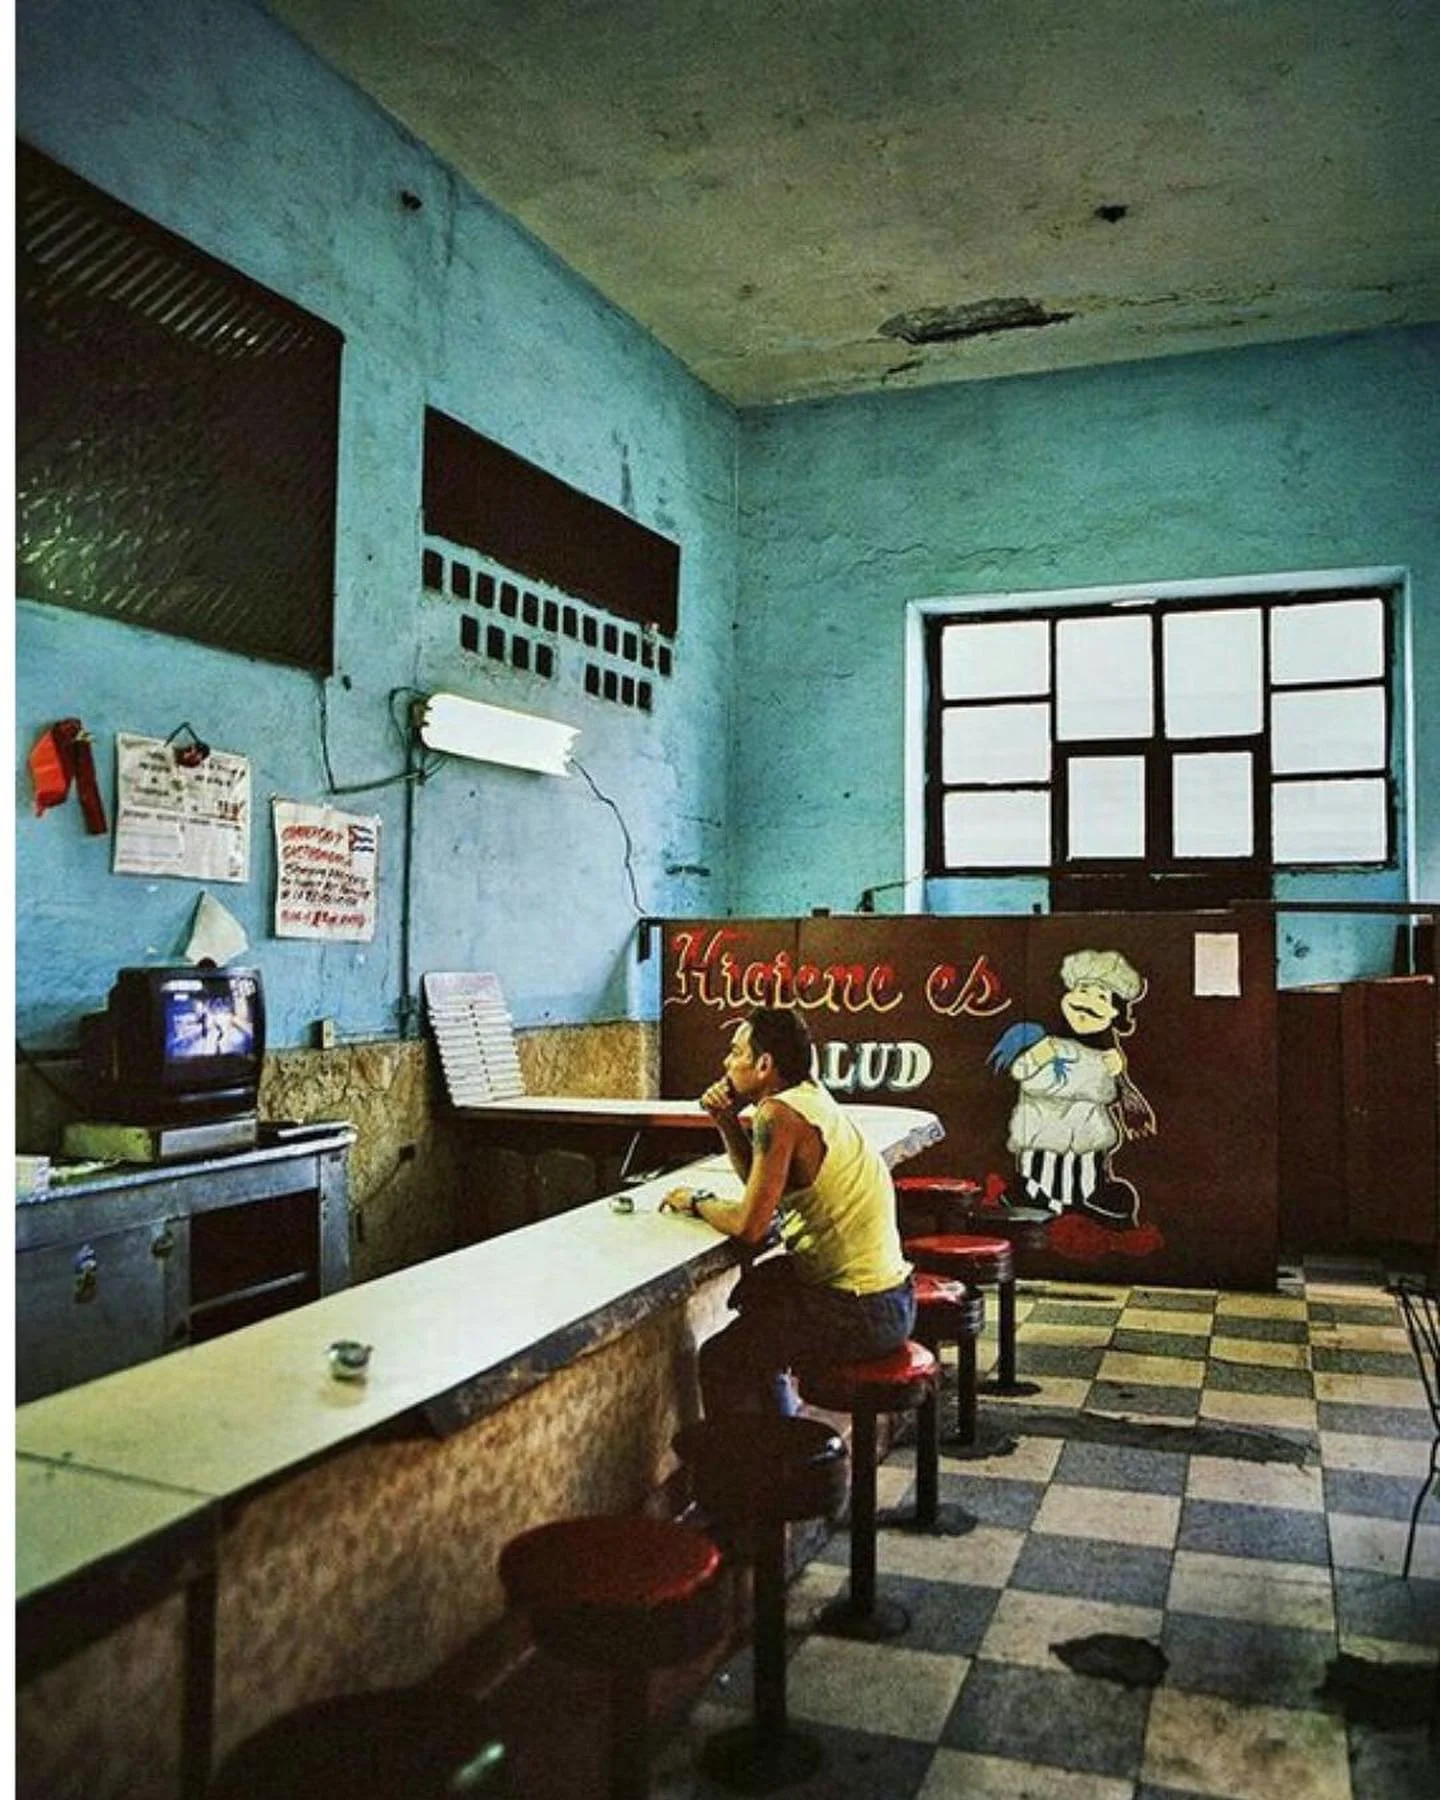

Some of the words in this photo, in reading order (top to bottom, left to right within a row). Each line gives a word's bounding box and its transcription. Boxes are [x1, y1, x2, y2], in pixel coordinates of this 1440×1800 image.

[666, 928, 903, 1014] Higiene
[926, 954, 1012, 1017] es
[811, 1040, 934, 1092] LUD
